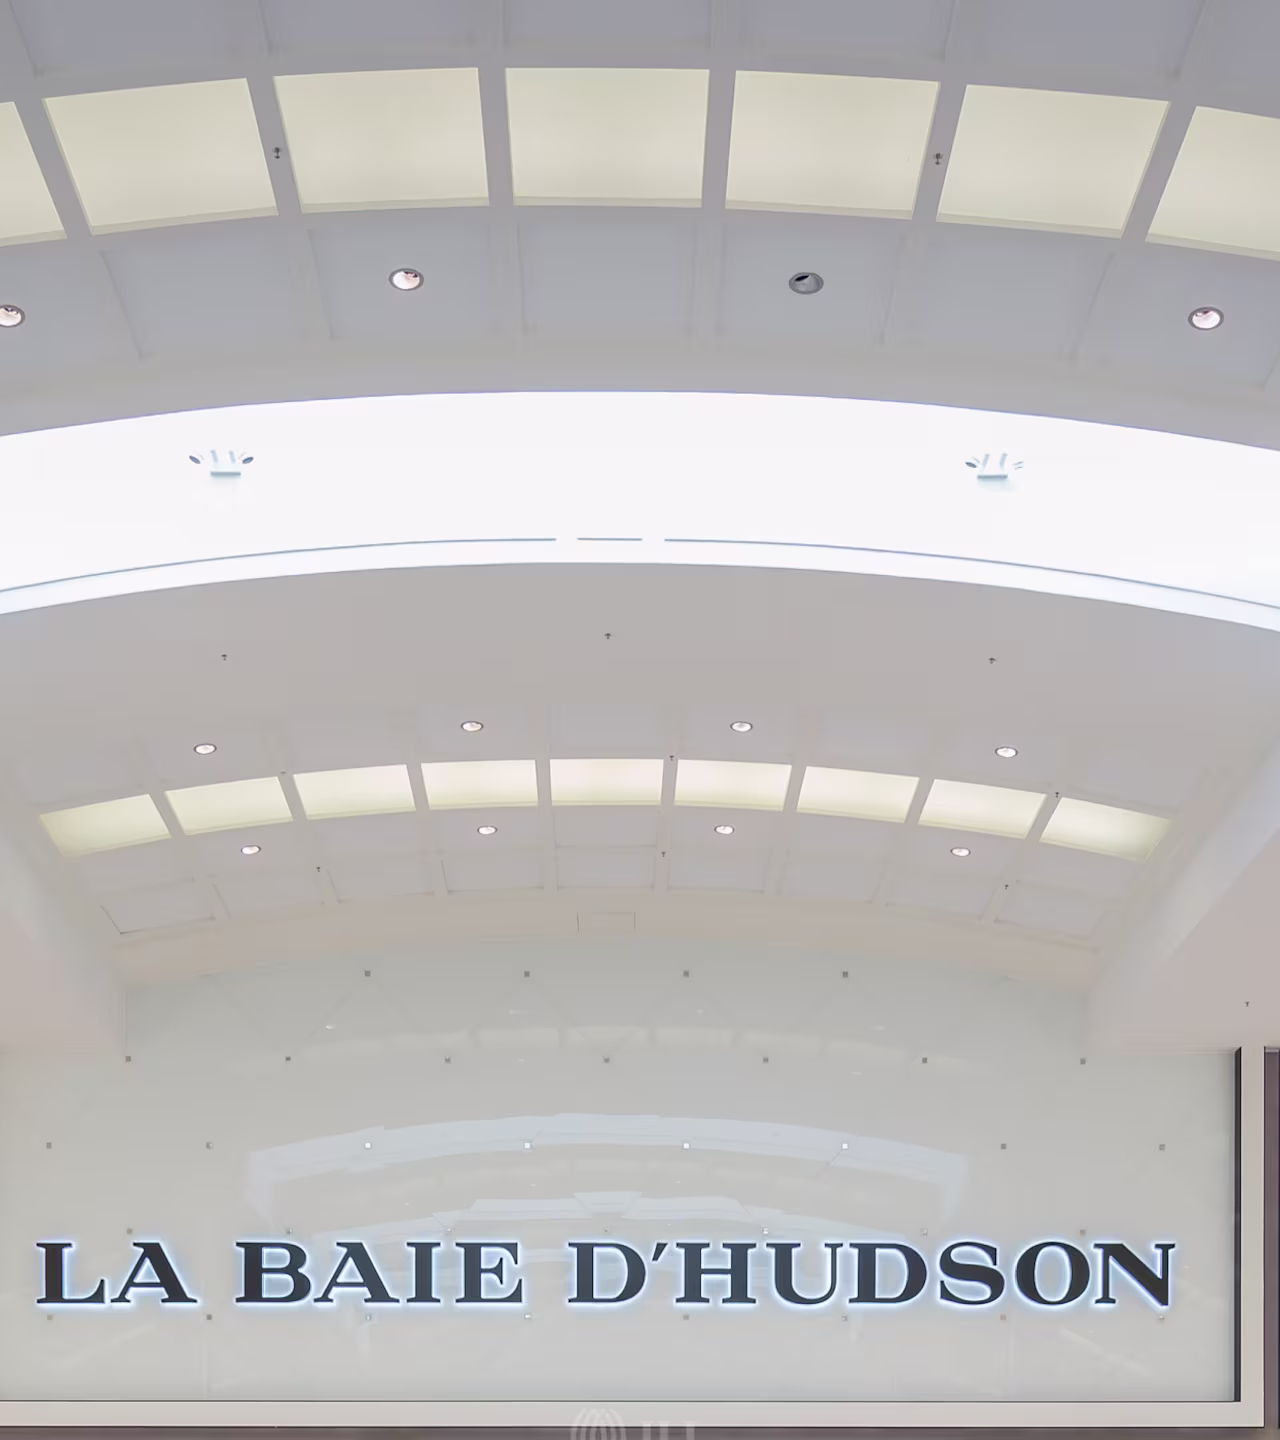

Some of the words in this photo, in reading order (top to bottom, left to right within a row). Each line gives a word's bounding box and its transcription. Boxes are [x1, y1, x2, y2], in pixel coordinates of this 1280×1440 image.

[36, 1240, 197, 1305] LA
[234, 1240, 523, 1305] BAIE
[567, 1240, 1176, 1306] D'HUDSON
